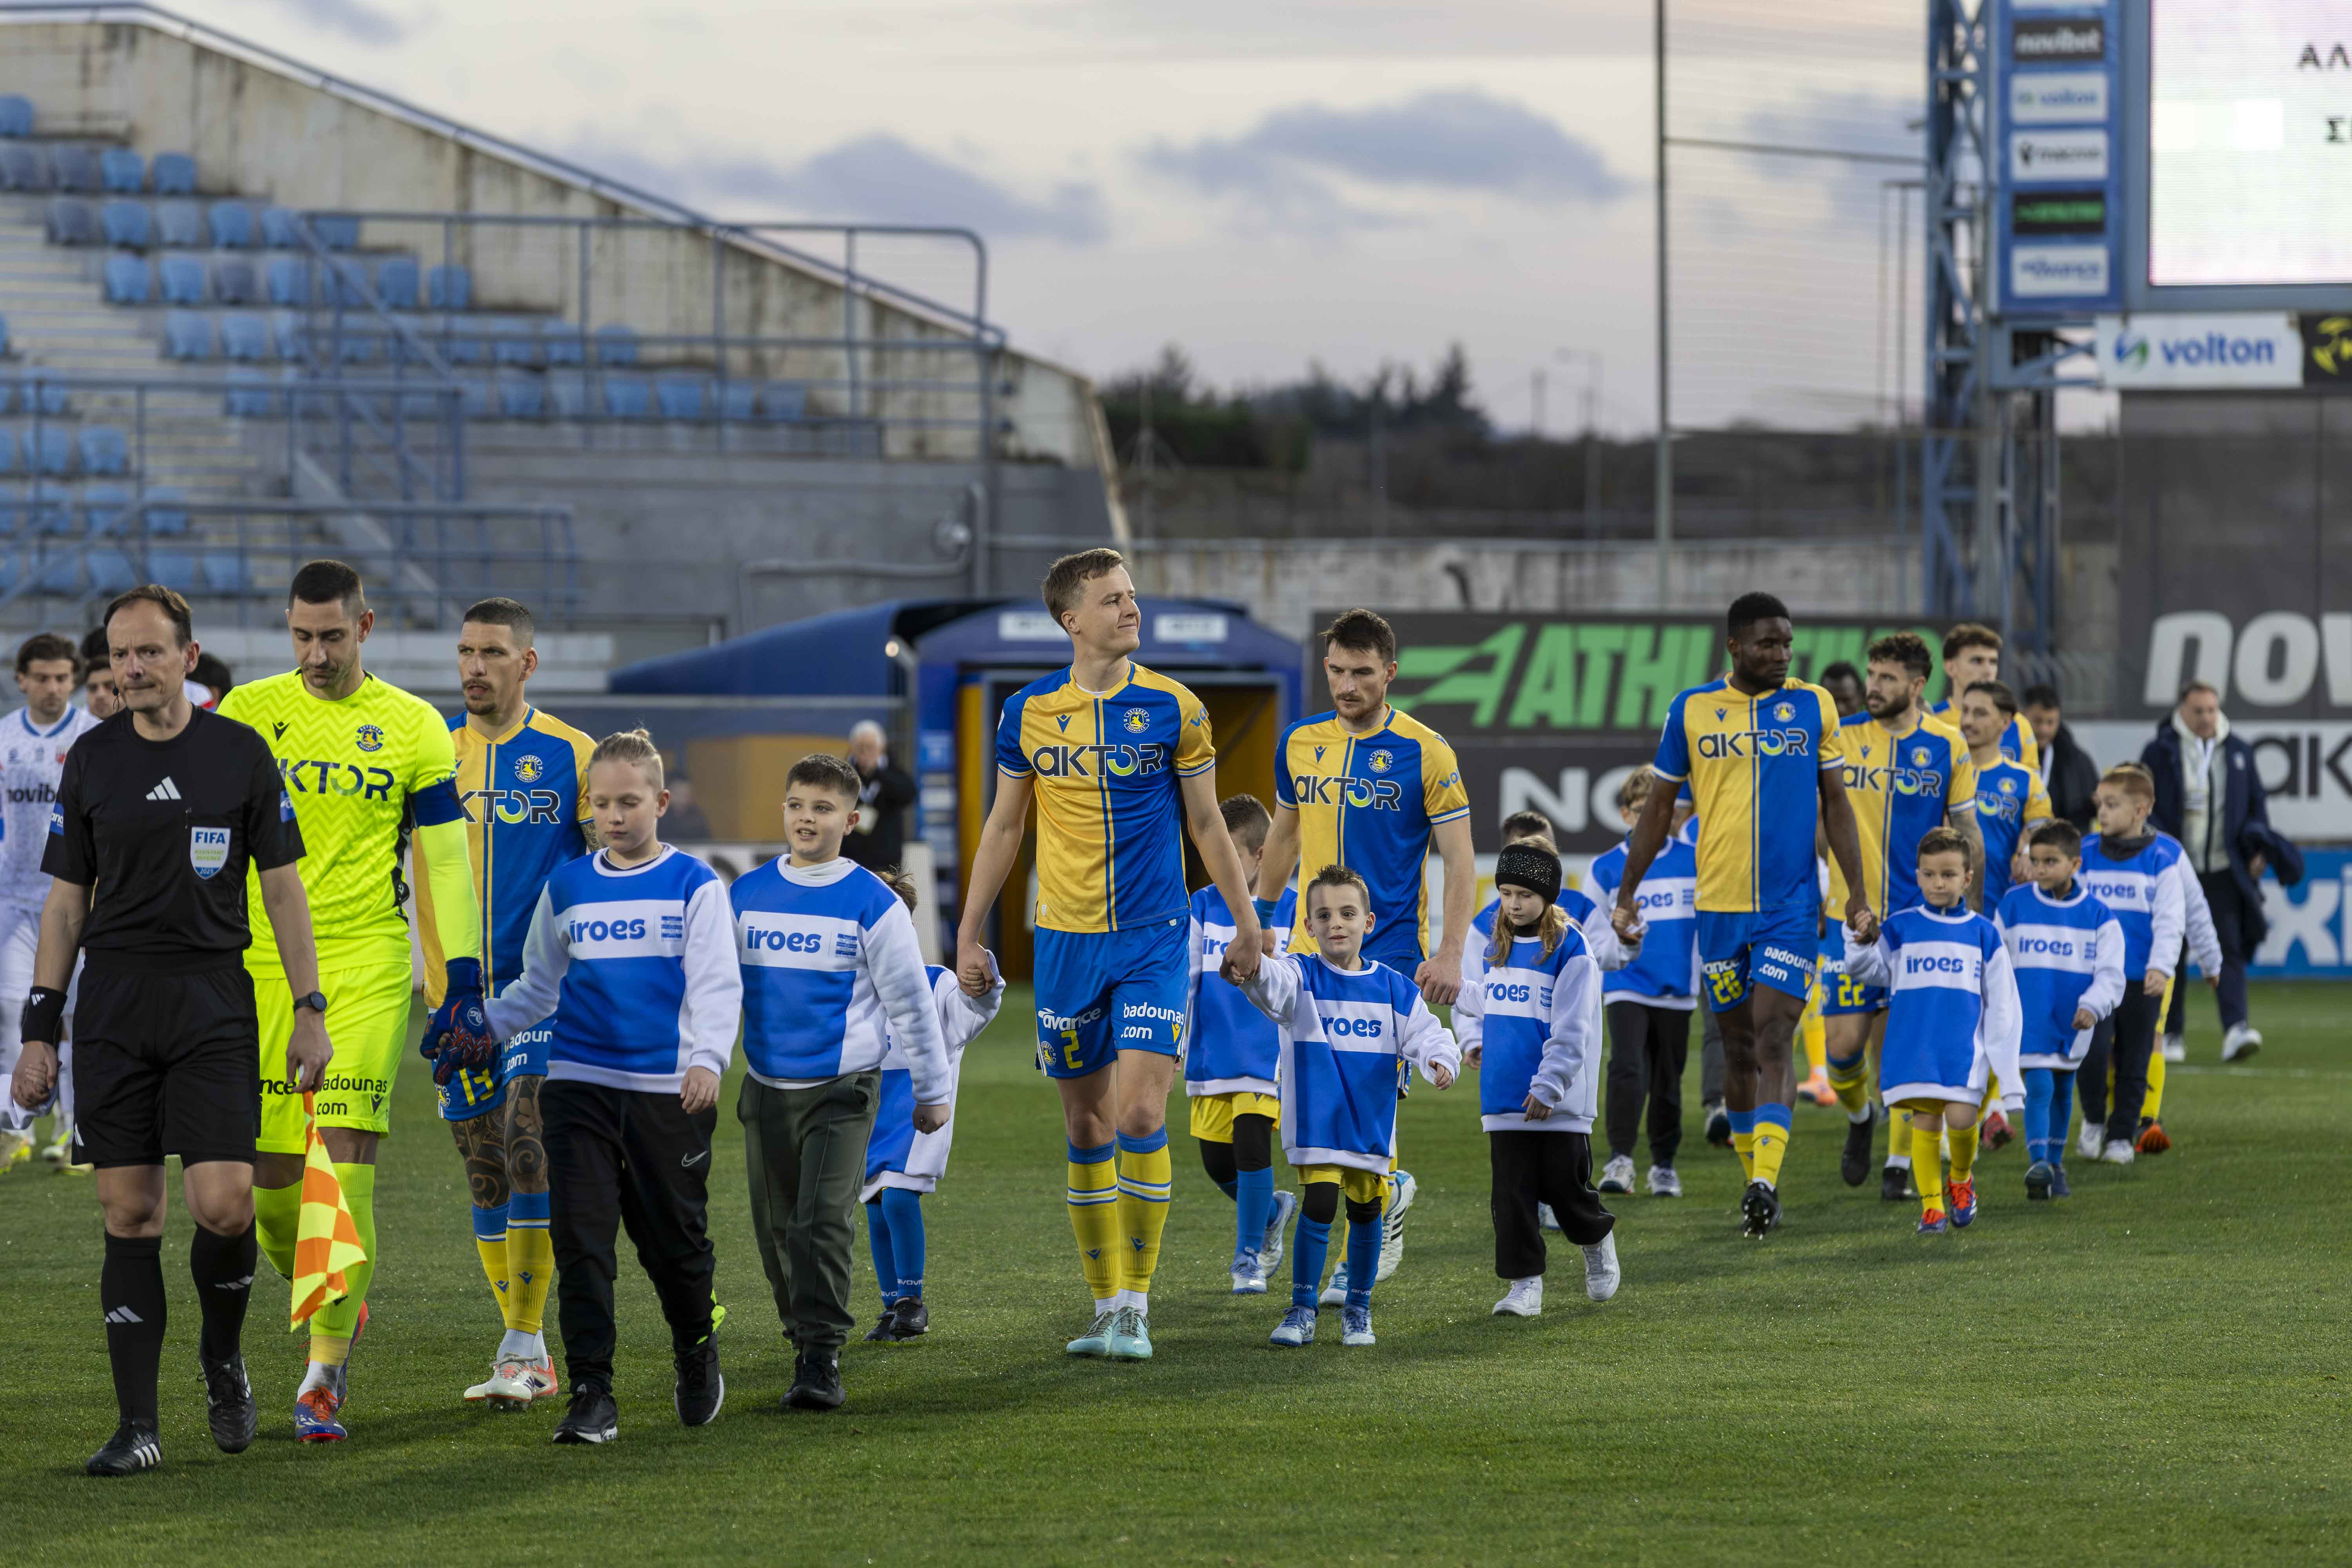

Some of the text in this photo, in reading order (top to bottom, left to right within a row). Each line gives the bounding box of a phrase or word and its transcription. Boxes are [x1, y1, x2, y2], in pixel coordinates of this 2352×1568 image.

[2161, 331, 2275, 365] volton
[274, 758, 394, 802] KTOR
[195, 831, 226, 844] FIFA
[569, 918, 646, 943] iroes
[747, 926, 822, 953] iroes
[2019, 937, 2073, 956] iroes
[1906, 955, 1964, 975] iroes
[1042, 1007, 1102, 1031] avance
[1123, 1002, 1184, 1025] badounas
[1120, 1026, 1152, 1040] .com
[1318, 1013, 1382, 1038] roes
[1060, 1029, 1083, 1069] 2
[319, 1073, 387, 1094] adounas
[314, 1102, 348, 1116] .com
